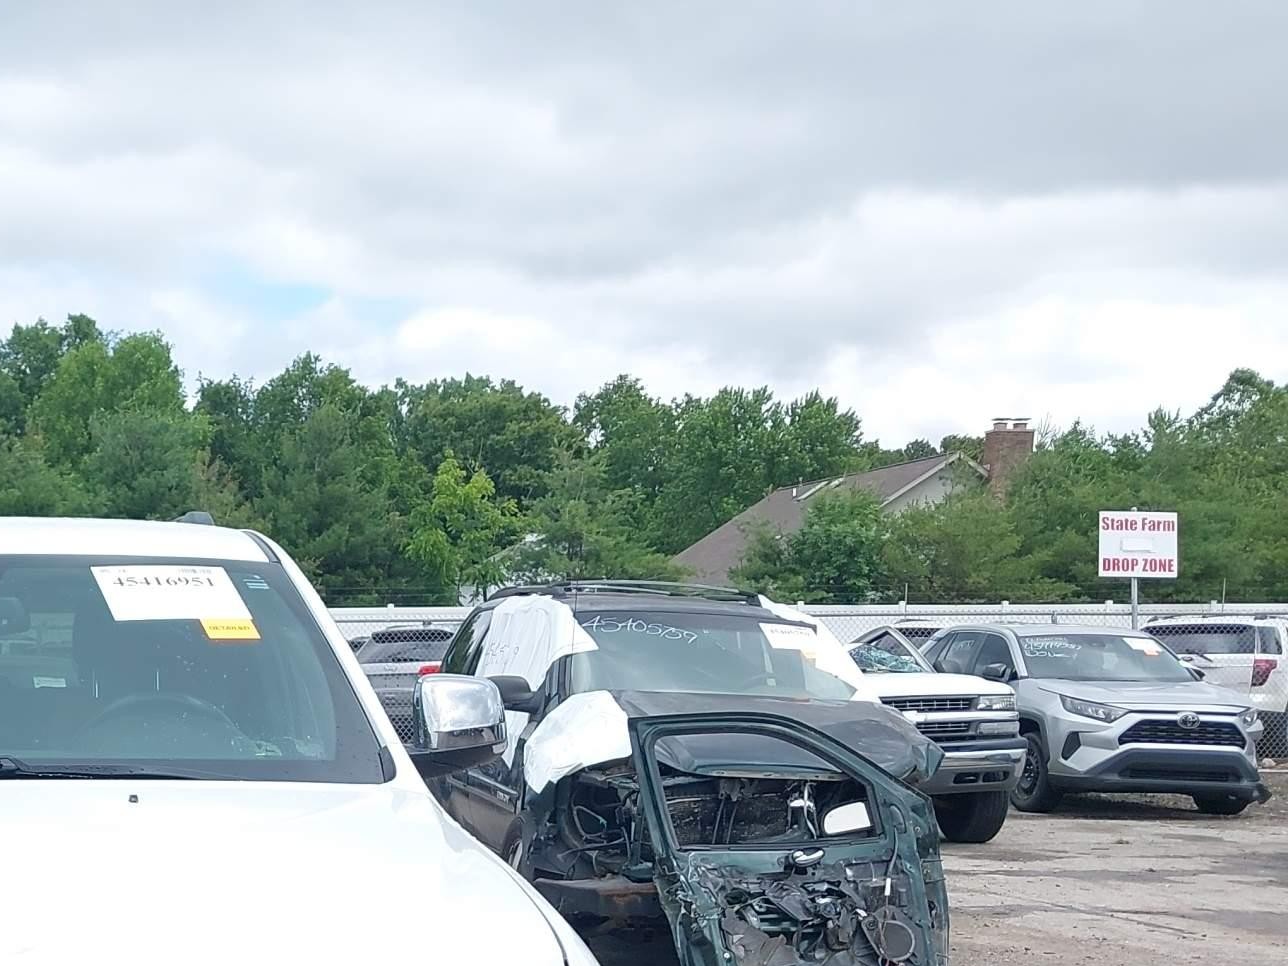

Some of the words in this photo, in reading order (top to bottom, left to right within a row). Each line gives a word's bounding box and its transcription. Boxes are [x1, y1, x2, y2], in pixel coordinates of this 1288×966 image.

[1101, 516, 1138, 532] State
[1141, 516, 1175, 533] Farm
[1102, 557, 1139, 572] DROP
[1141, 557, 1175, 573] ZONE
[112, 576, 216, 587] 45416951
